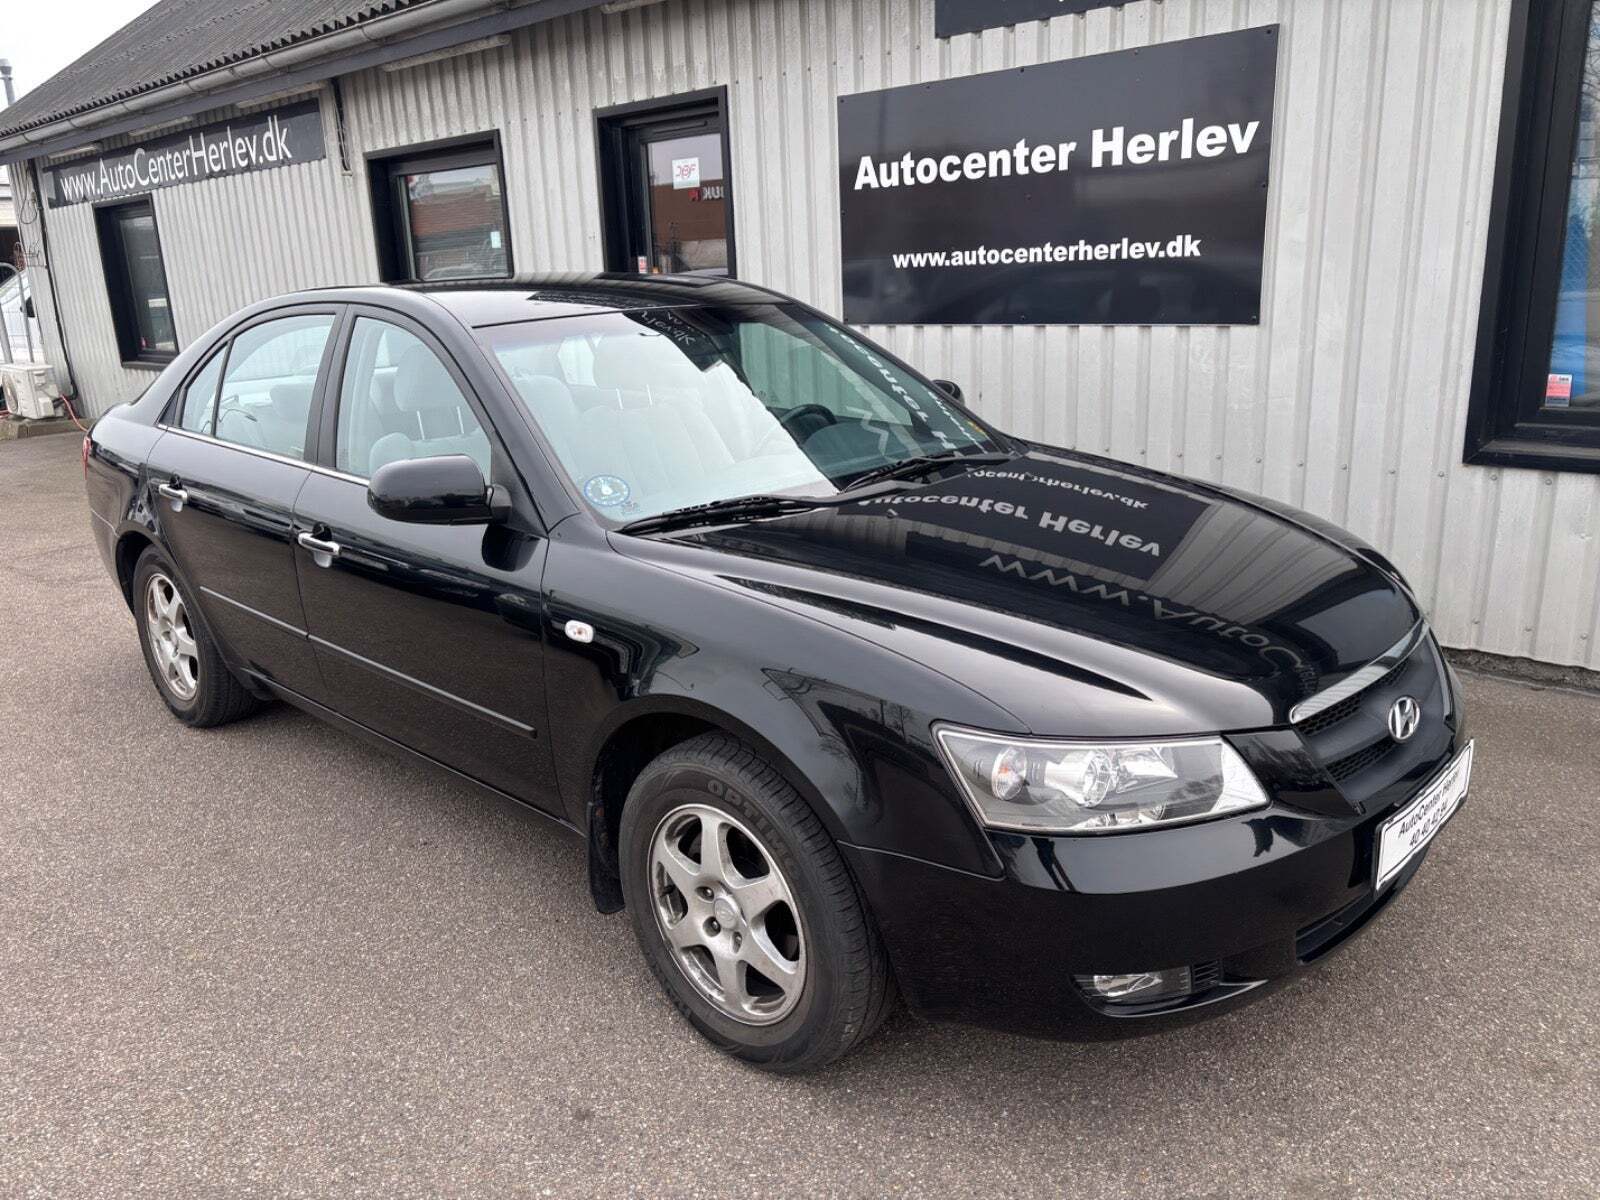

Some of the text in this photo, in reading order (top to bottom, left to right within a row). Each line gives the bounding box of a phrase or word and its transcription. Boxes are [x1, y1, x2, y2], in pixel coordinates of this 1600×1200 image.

[60, 115, 293, 200] www.AutoCenterHerlev.dk
[854, 118, 1260, 190] Autocenter Herlev
[893, 235, 1202, 269] www.autocenterherlev.dk
[1398, 790, 1442, 838] AutoCenter
